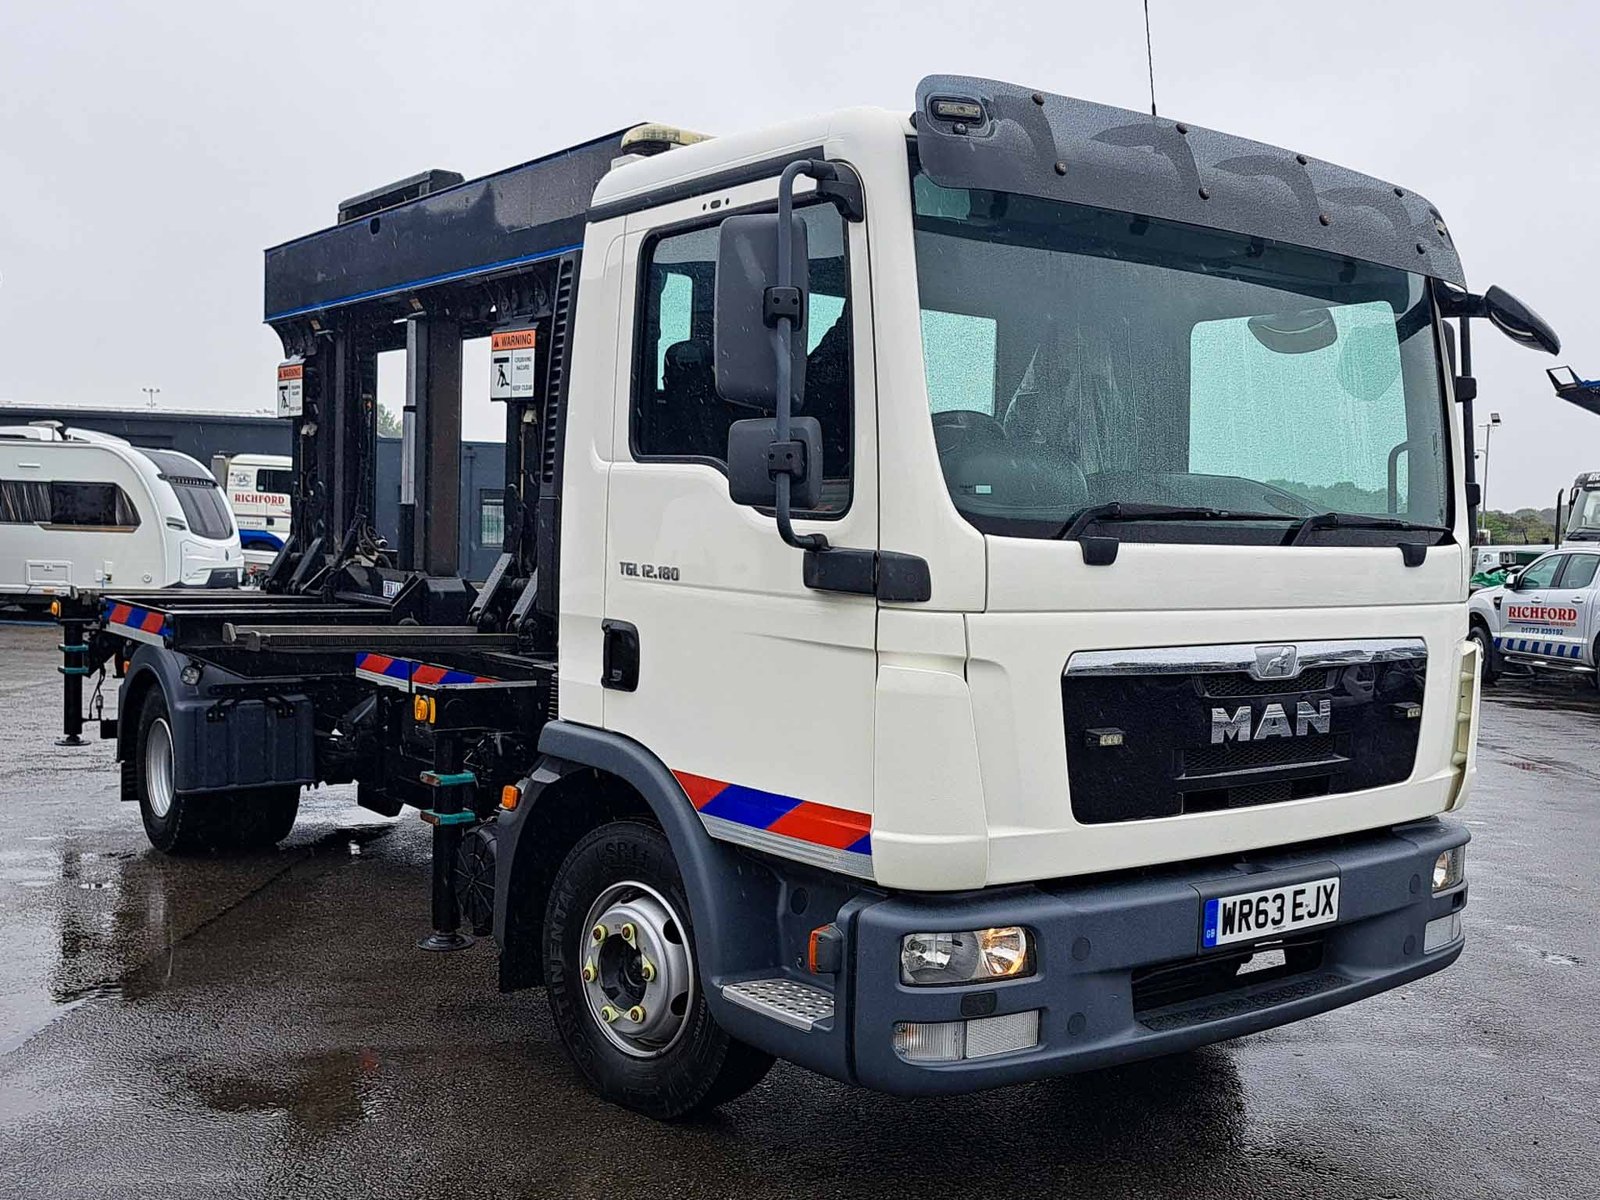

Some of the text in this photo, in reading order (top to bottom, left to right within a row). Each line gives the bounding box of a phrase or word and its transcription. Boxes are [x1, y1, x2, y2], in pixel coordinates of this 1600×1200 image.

[502, 334, 531, 347] WARNING
[234, 493, 285, 505] RICHFORD
[619, 561, 680, 581] TGL 12.180
[1508, 606, 1577, 621] RICHFORD
[1521, 627, 1540, 635] 01773
[1211, 699, 1331, 744] MAN
[1222, 883, 1336, 936] WR63 EJX
[1206, 928, 1216, 939] GB
